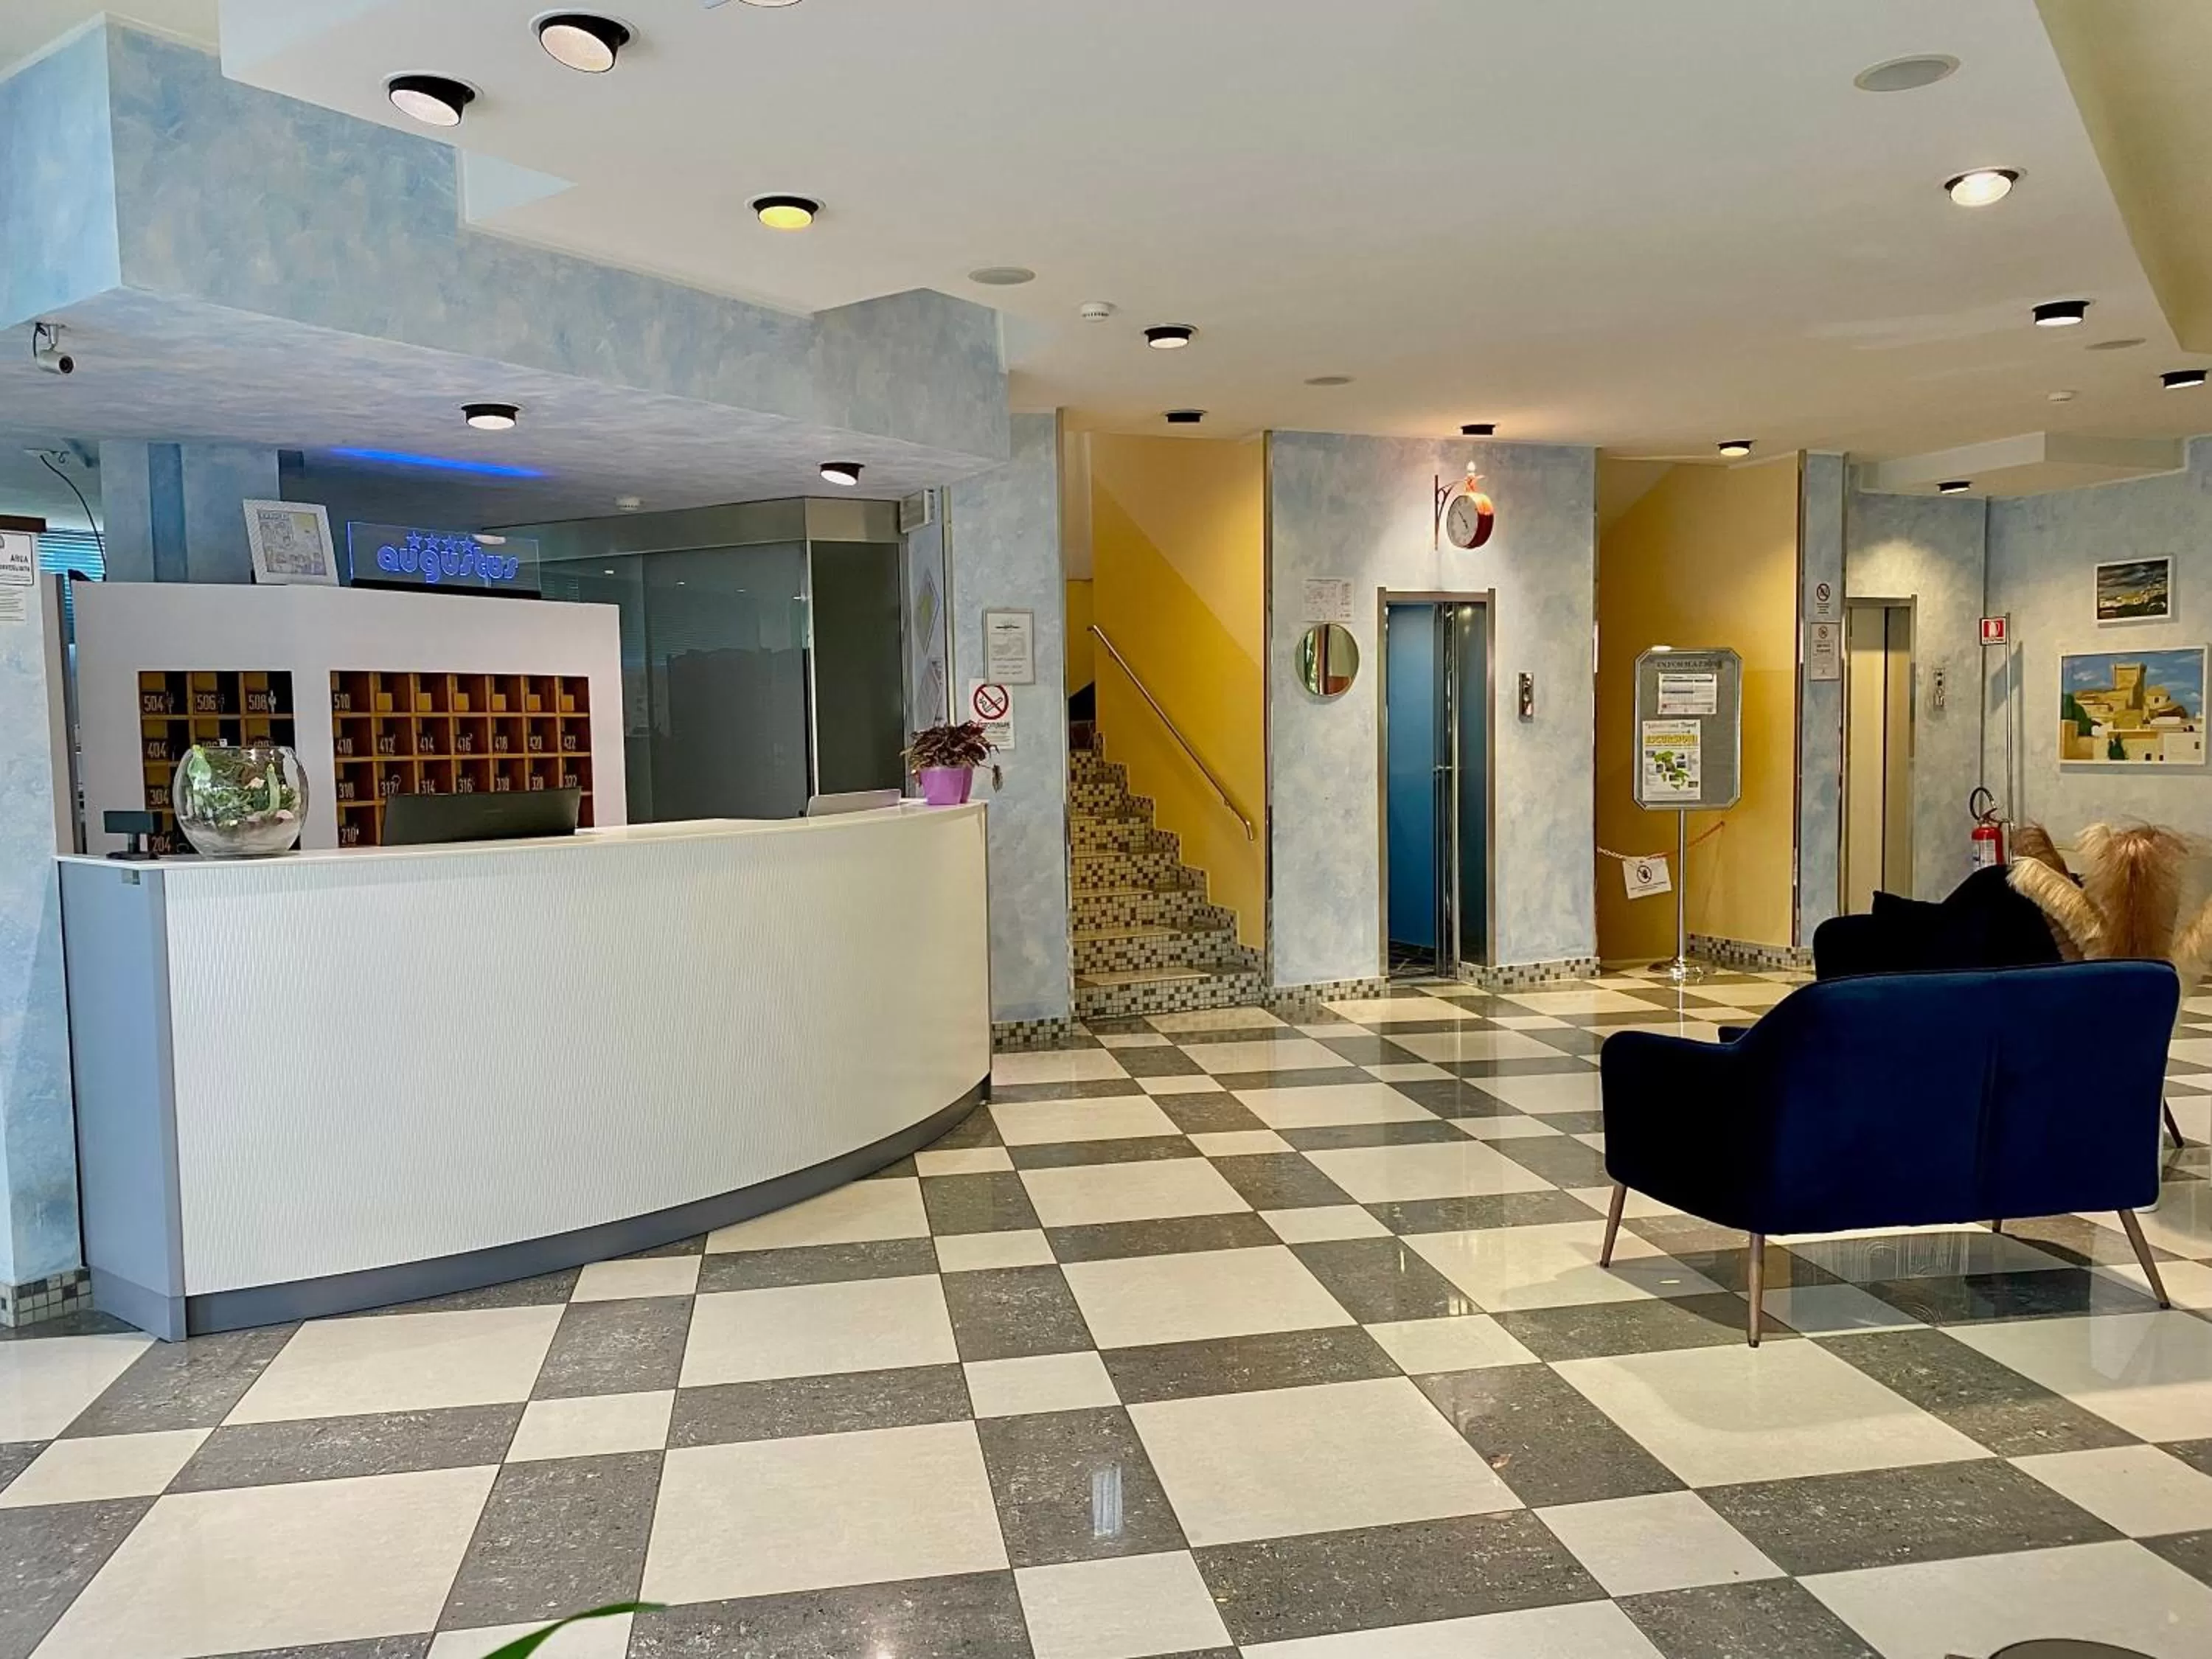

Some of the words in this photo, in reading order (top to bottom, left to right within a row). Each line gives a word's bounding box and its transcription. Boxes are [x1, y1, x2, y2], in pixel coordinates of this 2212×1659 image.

[377, 544, 518, 583] augustus
[144, 695, 165, 712] 504
[196, 693, 217, 711] 506
[334, 692, 351, 709] 510
[147, 741, 167, 758] 404
[337, 737, 353, 754] 410
[420, 737, 434, 752] 414
[457, 737, 472, 751] 416
[458, 777, 473, 793] 316
[150, 788, 170, 804] 304
[152, 833, 171, 852] 204
